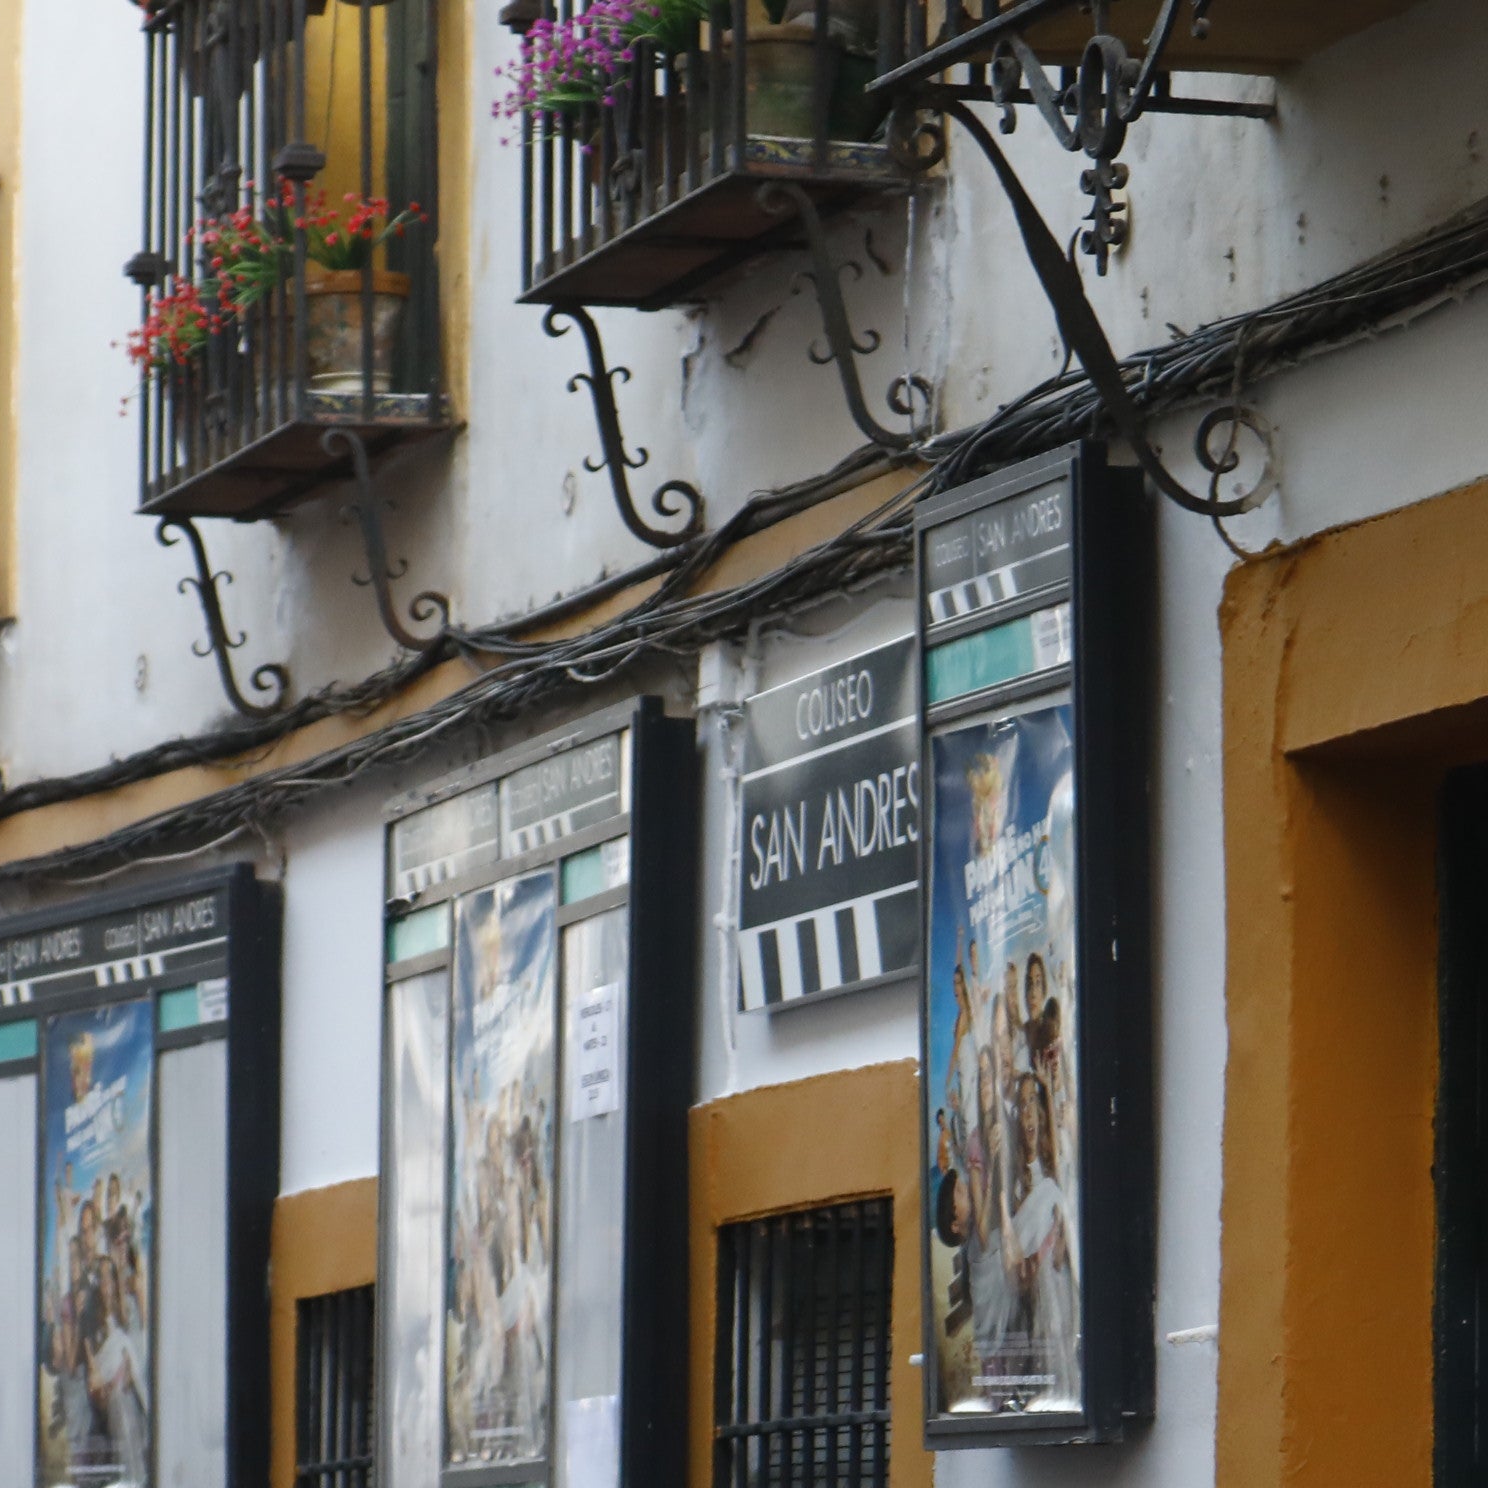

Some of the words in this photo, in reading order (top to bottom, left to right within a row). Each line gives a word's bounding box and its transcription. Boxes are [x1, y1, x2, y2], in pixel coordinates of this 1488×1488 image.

[978, 516, 1005, 557] SAN
[1011, 494, 1061, 543] ANDRES
[796, 669, 872, 740] COLISEO
[750, 801, 806, 890] SAN
[817, 761, 919, 871] ANDRES
[14, 938, 36, 970] SAN
[40, 928, 81, 963] ANDRES
[144, 909, 168, 942] SAN
[172, 896, 216, 935] ANDRES
